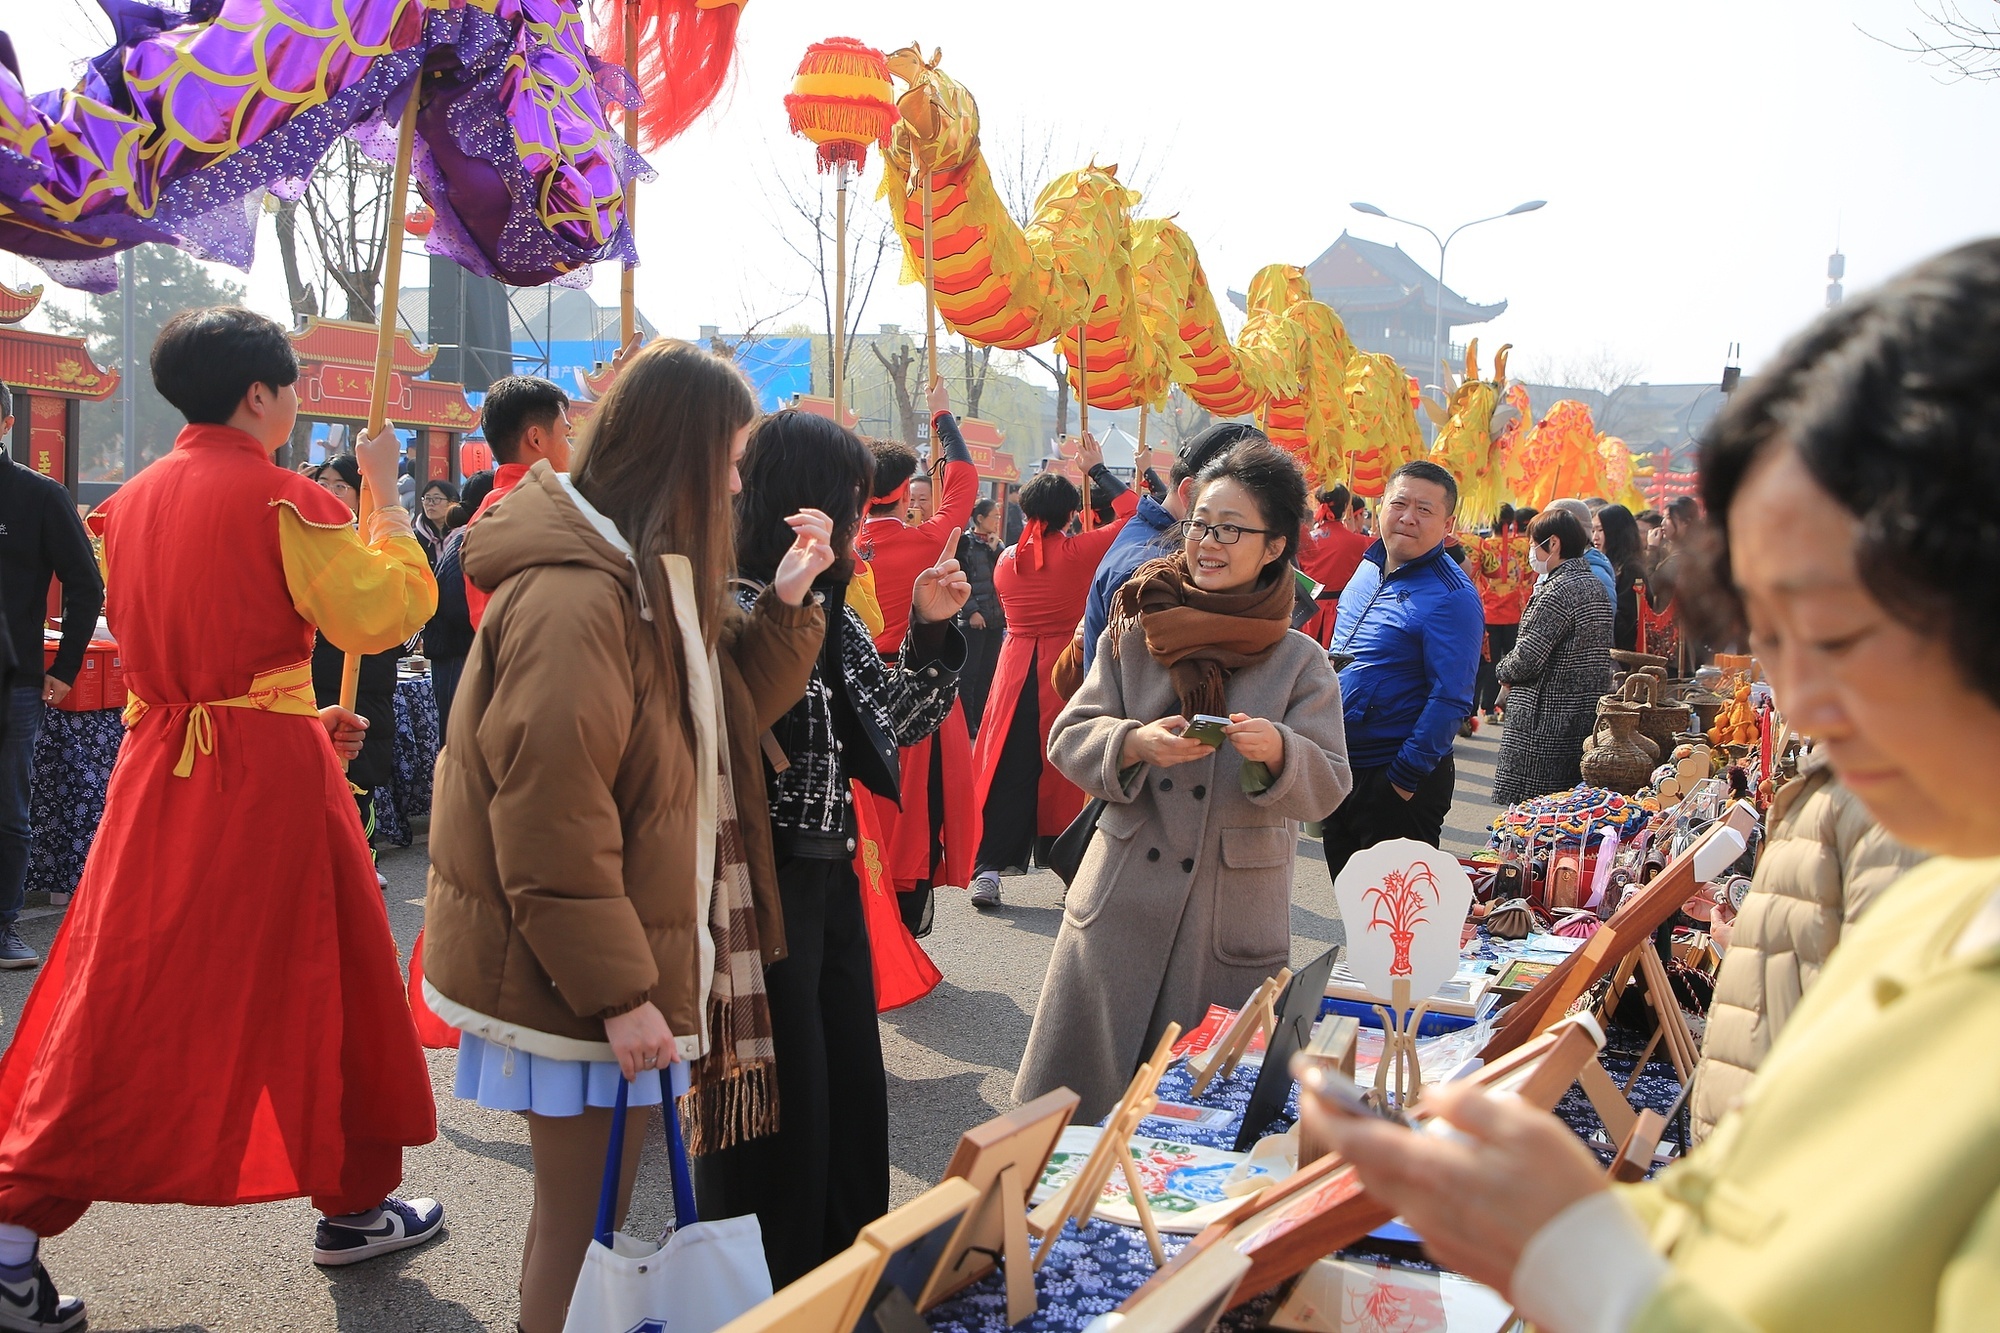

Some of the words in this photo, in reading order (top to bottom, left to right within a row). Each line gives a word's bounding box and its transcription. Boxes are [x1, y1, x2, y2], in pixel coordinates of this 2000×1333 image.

[512, 365, 585, 379] 质文化遗产
